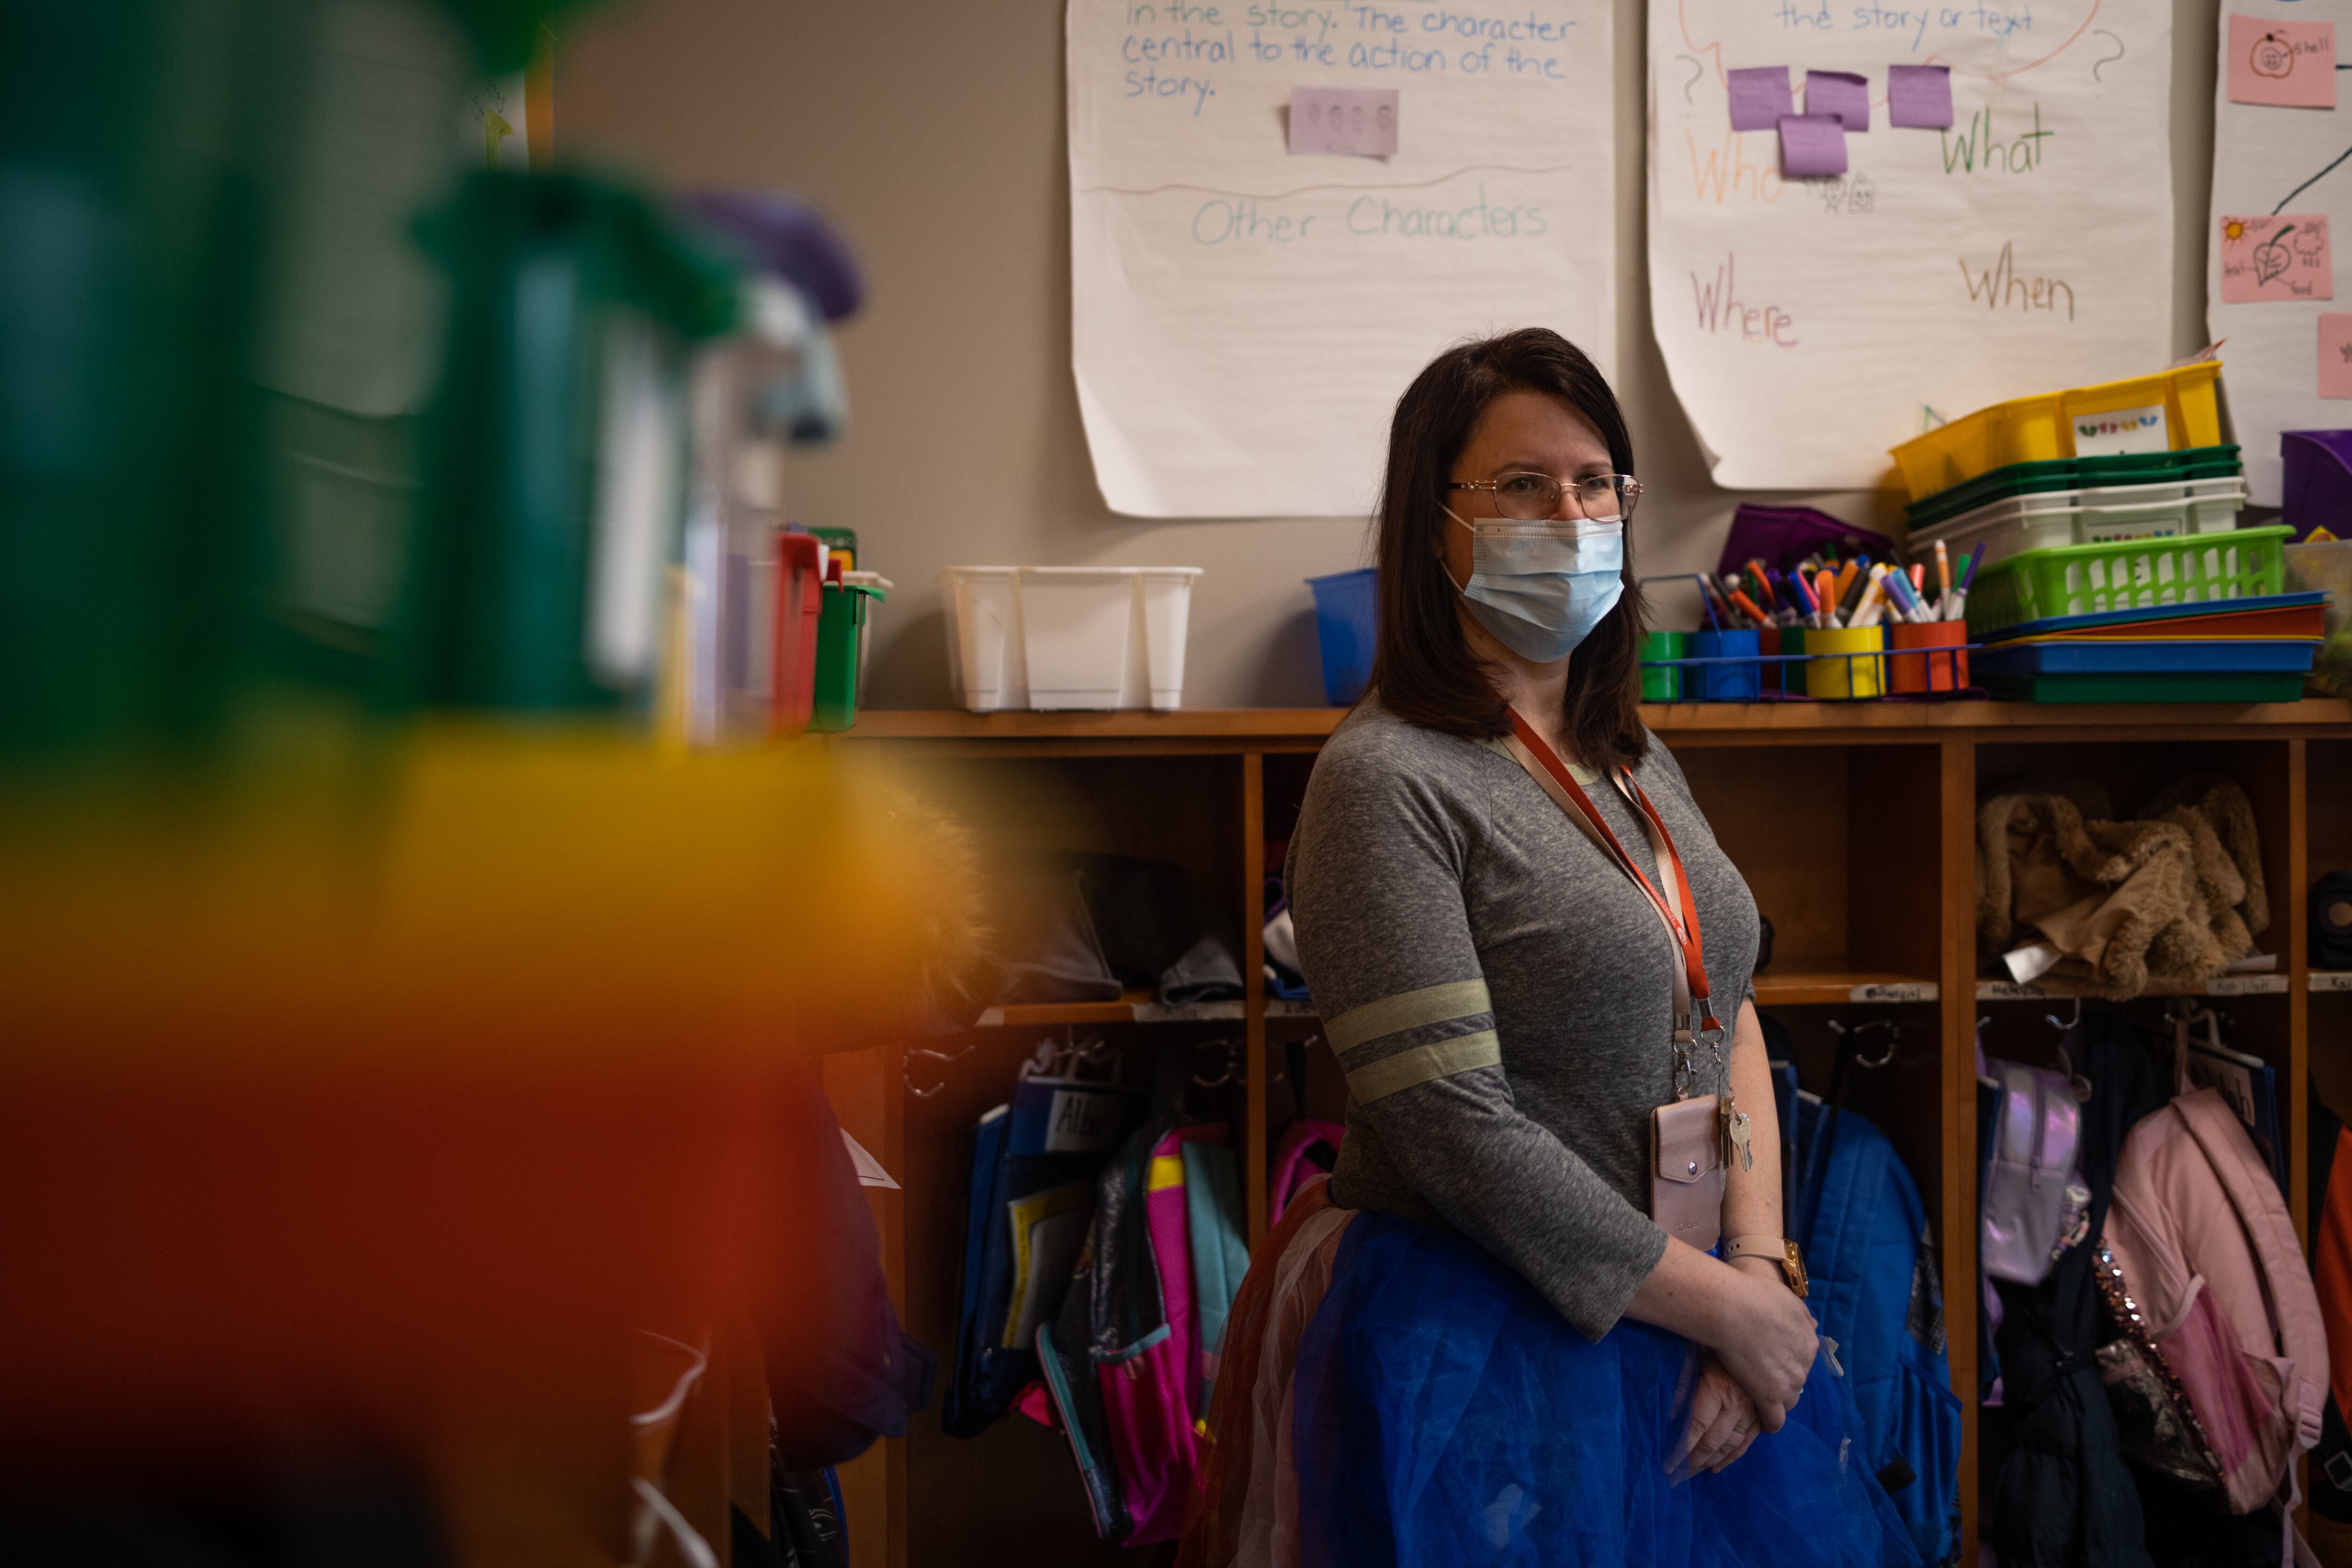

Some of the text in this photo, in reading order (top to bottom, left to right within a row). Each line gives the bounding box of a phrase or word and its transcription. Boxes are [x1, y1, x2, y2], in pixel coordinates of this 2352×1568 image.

[1122, 30, 1565, 79] central to the action of the
[1164, 0, 1223, 25] the
[1246, 0, 1337, 46] story.
[1352, 7, 1408, 32] The
[1422, 9, 1577, 41] character
[1774, 0, 2032, 52] the story or text
[1685, 120, 1788, 204] Who
[1940, 100, 2055, 175] What
[1192, 182, 1547, 245] Other Characters
[1690, 250, 1798, 351] Where
[1958, 239, 2074, 323] When
